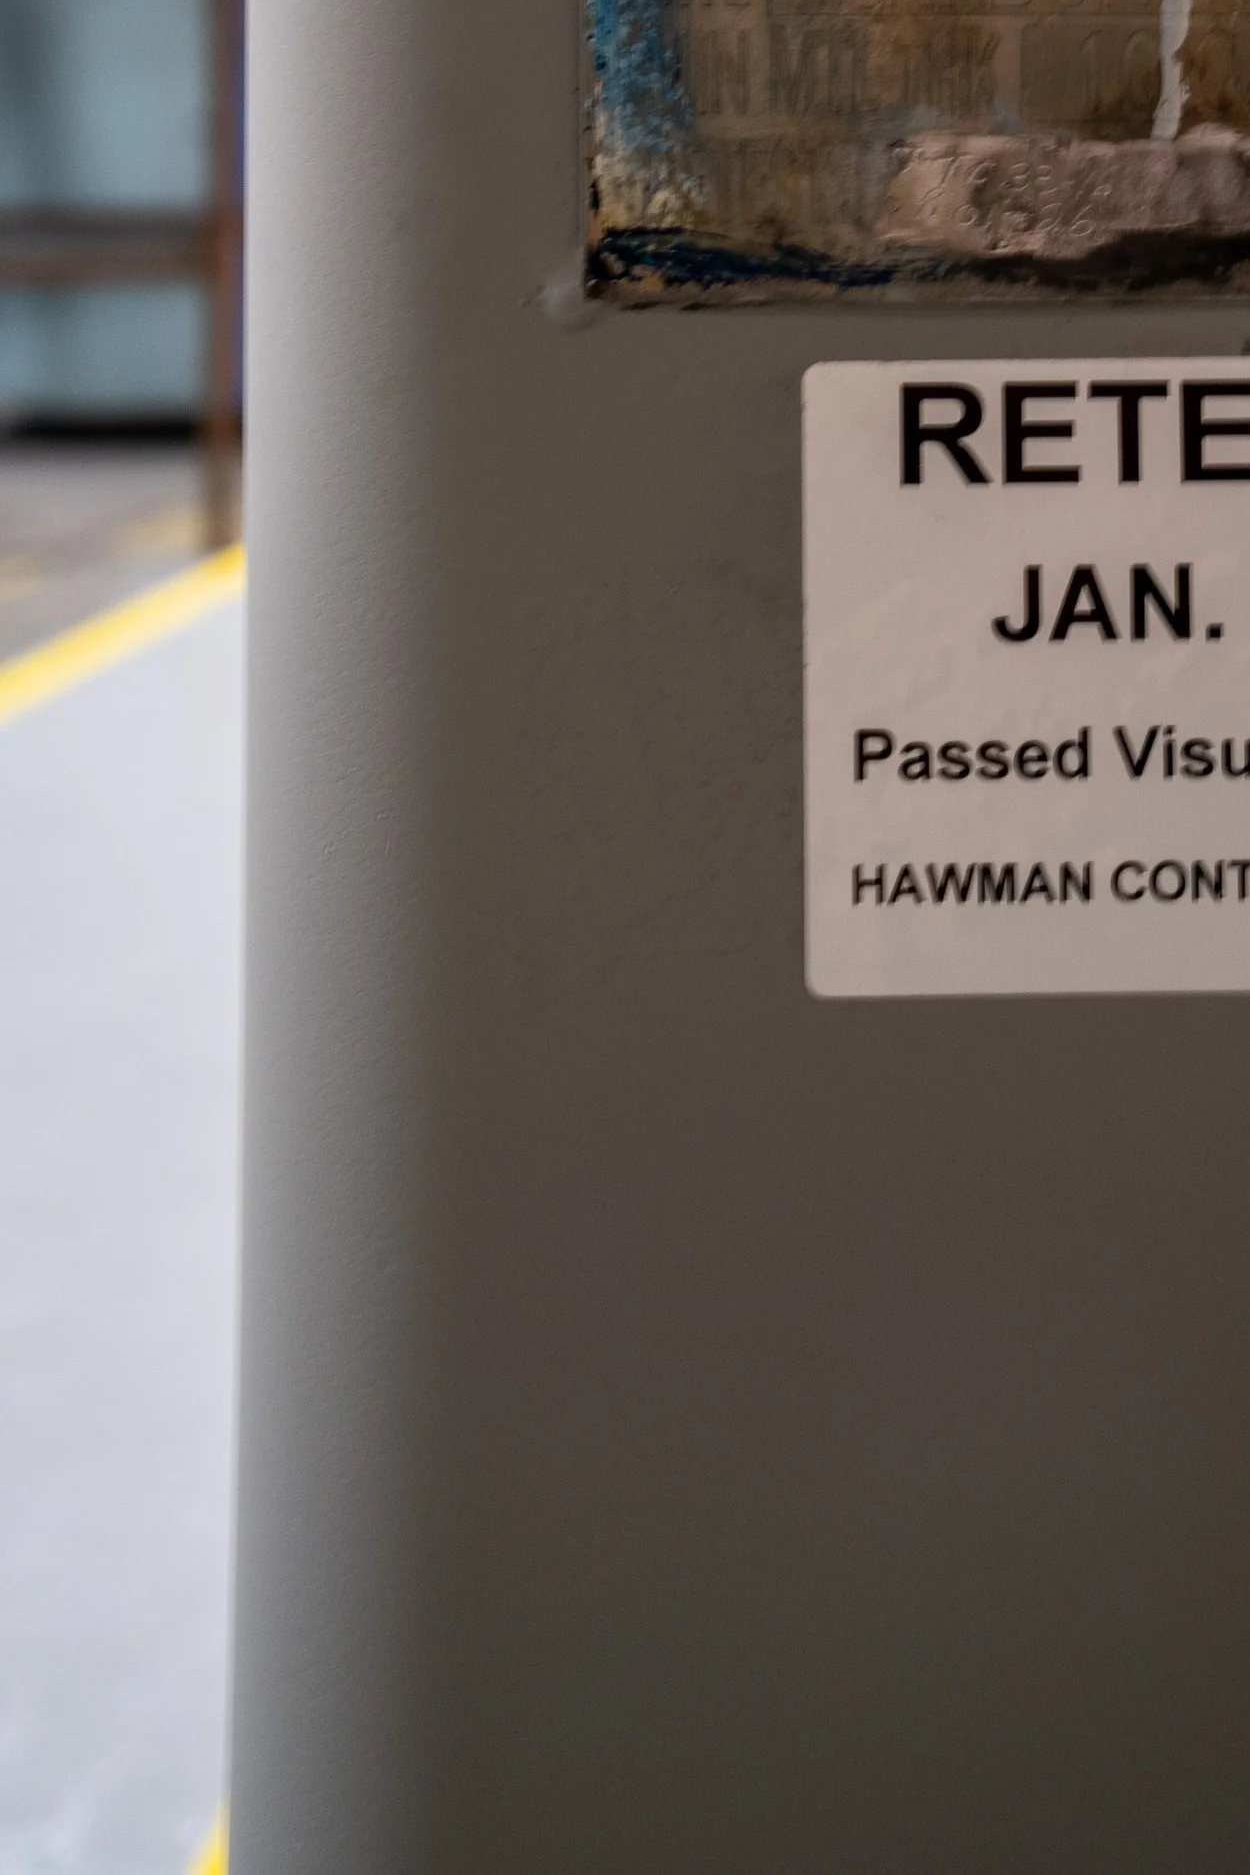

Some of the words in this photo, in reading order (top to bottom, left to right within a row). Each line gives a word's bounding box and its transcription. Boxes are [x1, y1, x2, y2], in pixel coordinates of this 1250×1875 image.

[992, 563, 1224, 642] JAN.
[853, 727, 1092, 782] Passed
[851, 861, 1094, 907] HAWMAN
